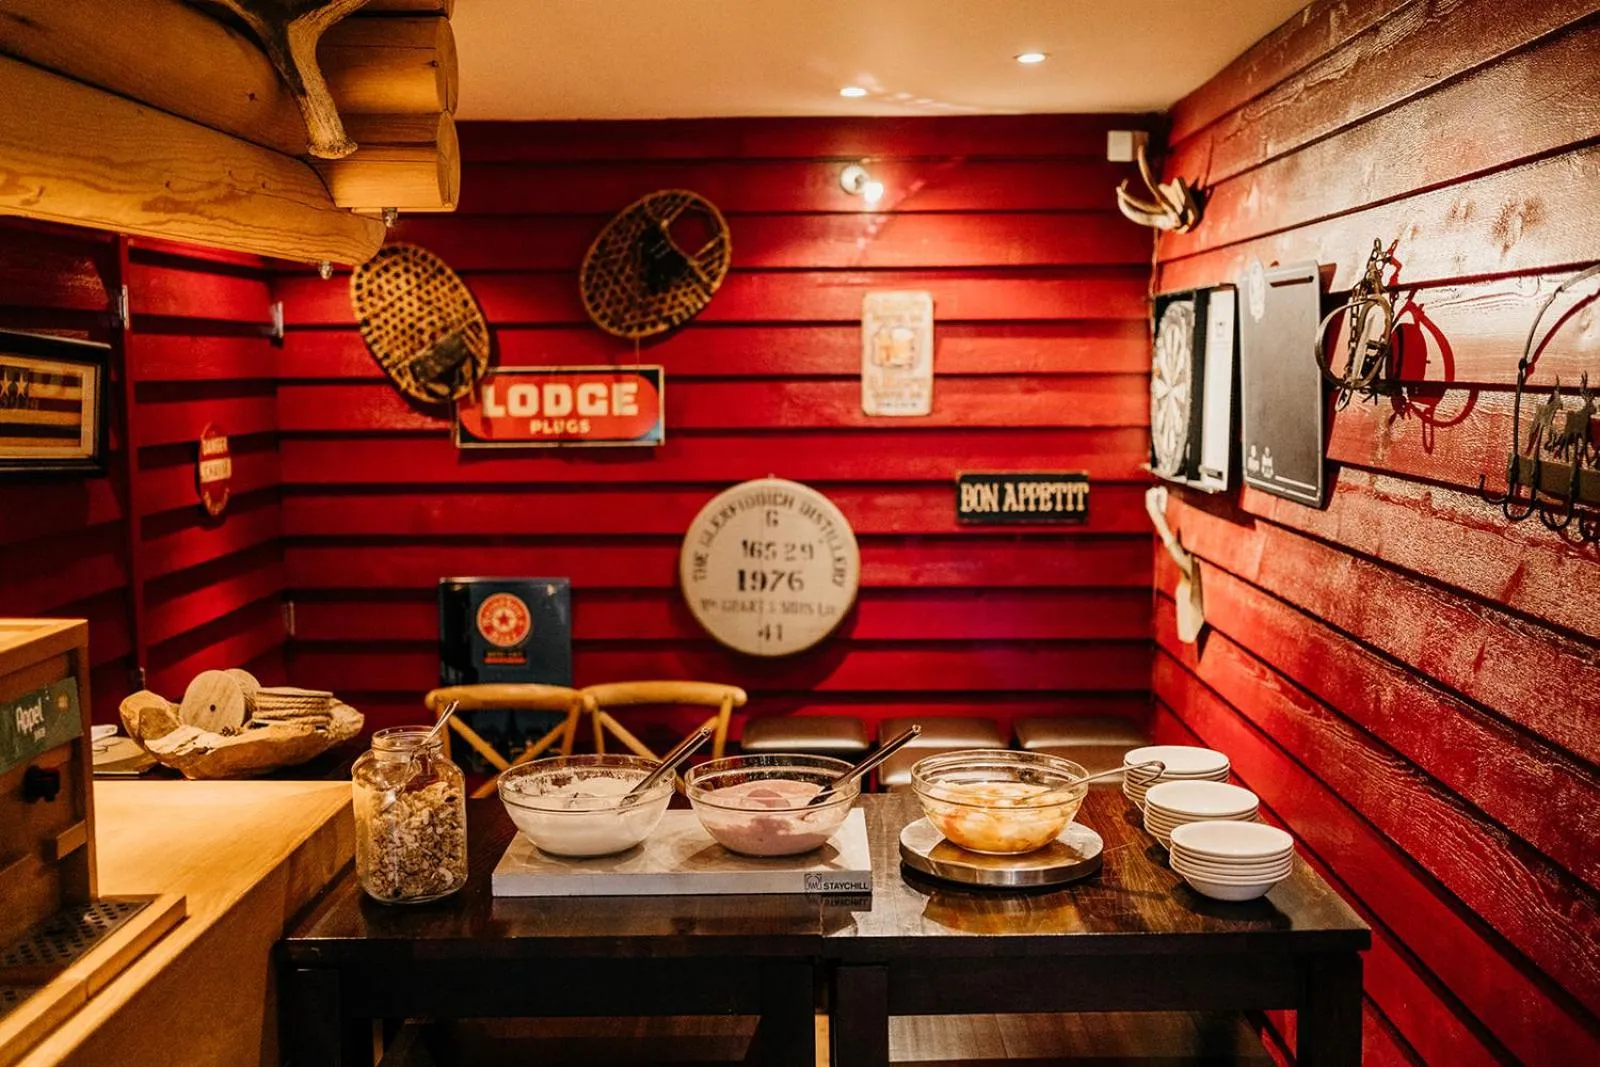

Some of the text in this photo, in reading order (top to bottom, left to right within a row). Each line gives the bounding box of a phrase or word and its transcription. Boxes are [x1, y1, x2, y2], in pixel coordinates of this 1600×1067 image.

[482, 382, 639, 418] LODGE
[529, 419, 591, 435] PLUGS
[960, 481, 1090, 513] BON APPETIT
[737, 568, 805, 593] 1976
[757, 624, 783, 641] 41
[16, 697, 44, 736] Appel
[823, 881, 869, 890] STAYCHILL
